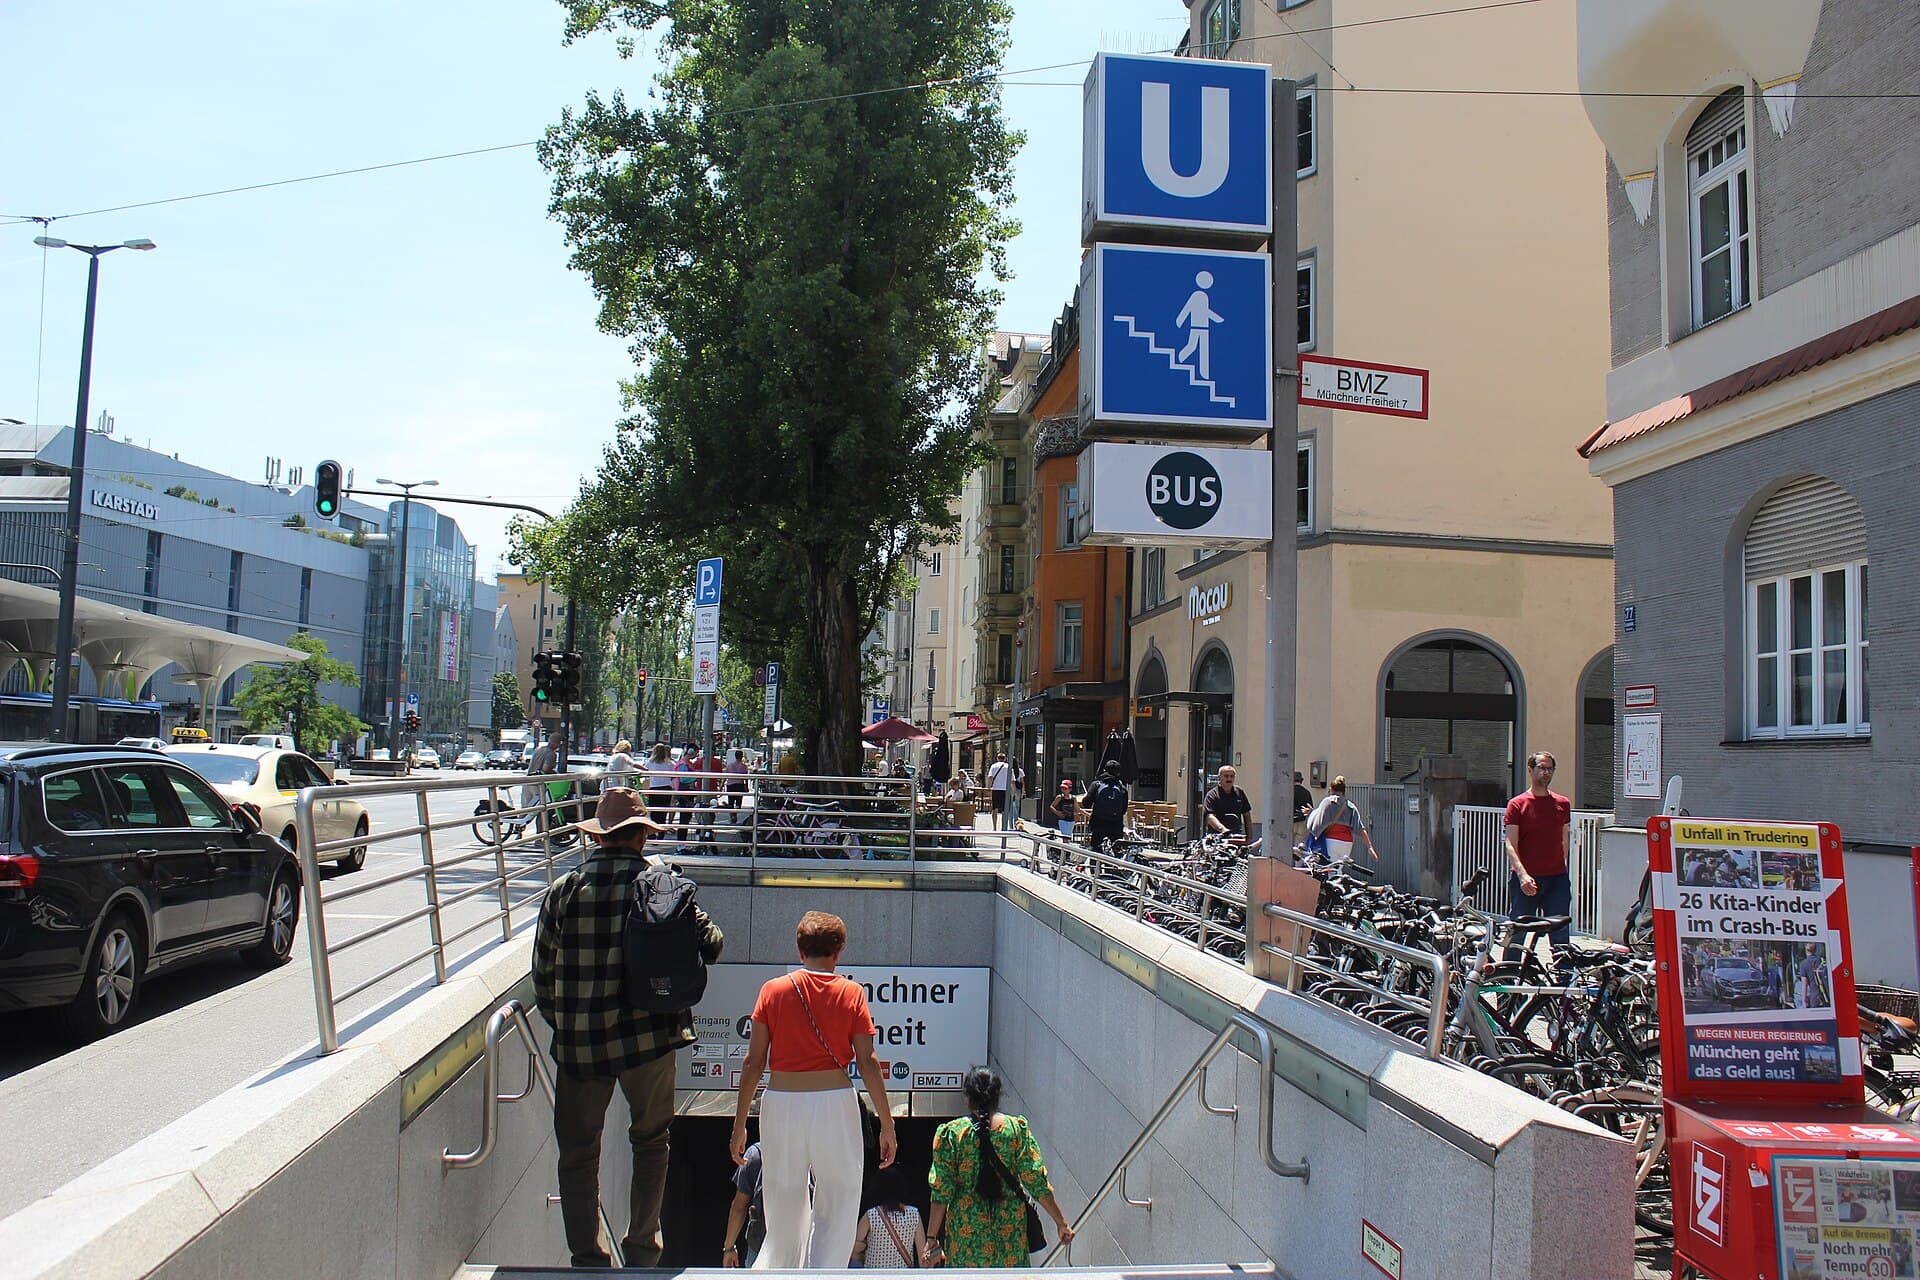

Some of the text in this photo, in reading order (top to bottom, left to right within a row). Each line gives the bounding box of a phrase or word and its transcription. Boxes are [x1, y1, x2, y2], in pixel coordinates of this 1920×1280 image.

[1141, 81, 1230, 198] U
[1337, 369, 1389, 396] BMZ
[1316, 389, 1408, 409] Münchner Freiheit 7
[1150, 474, 1218, 507] BUS
[92, 489, 160, 520] KARSTADT
[700, 565, 714, 600] P
[768, 665, 776, 683] P
[1682, 827, 1809, 847] Unfall in Trudering
[1679, 893, 1822, 914] 26 Kita-Kinder
[1687, 915, 1818, 937] im Crash-Bus
[862, 975, 960, 1004] nchner
[698, 1030, 731, 1039] ntrance
[871, 1017, 926, 1045] heit
[1695, 1029, 1822, 1042] WEGEN NEUER REGIERUNG
[1689, 1045, 1800, 1063] München geht
[693, 1065, 706, 1074] WC
[1695, 1064, 1796, 1080] das Geld aus!
[917, 1076, 942, 1086] BMZ
[1693, 1150, 1723, 1236] tz
[1785, 1171, 1815, 1212] tz
[1823, 1242, 1855, 1254] Noch
[1860, 1244, 1891, 1256] mehr
[1824, 1259, 1889, 1277] Tempo 30
